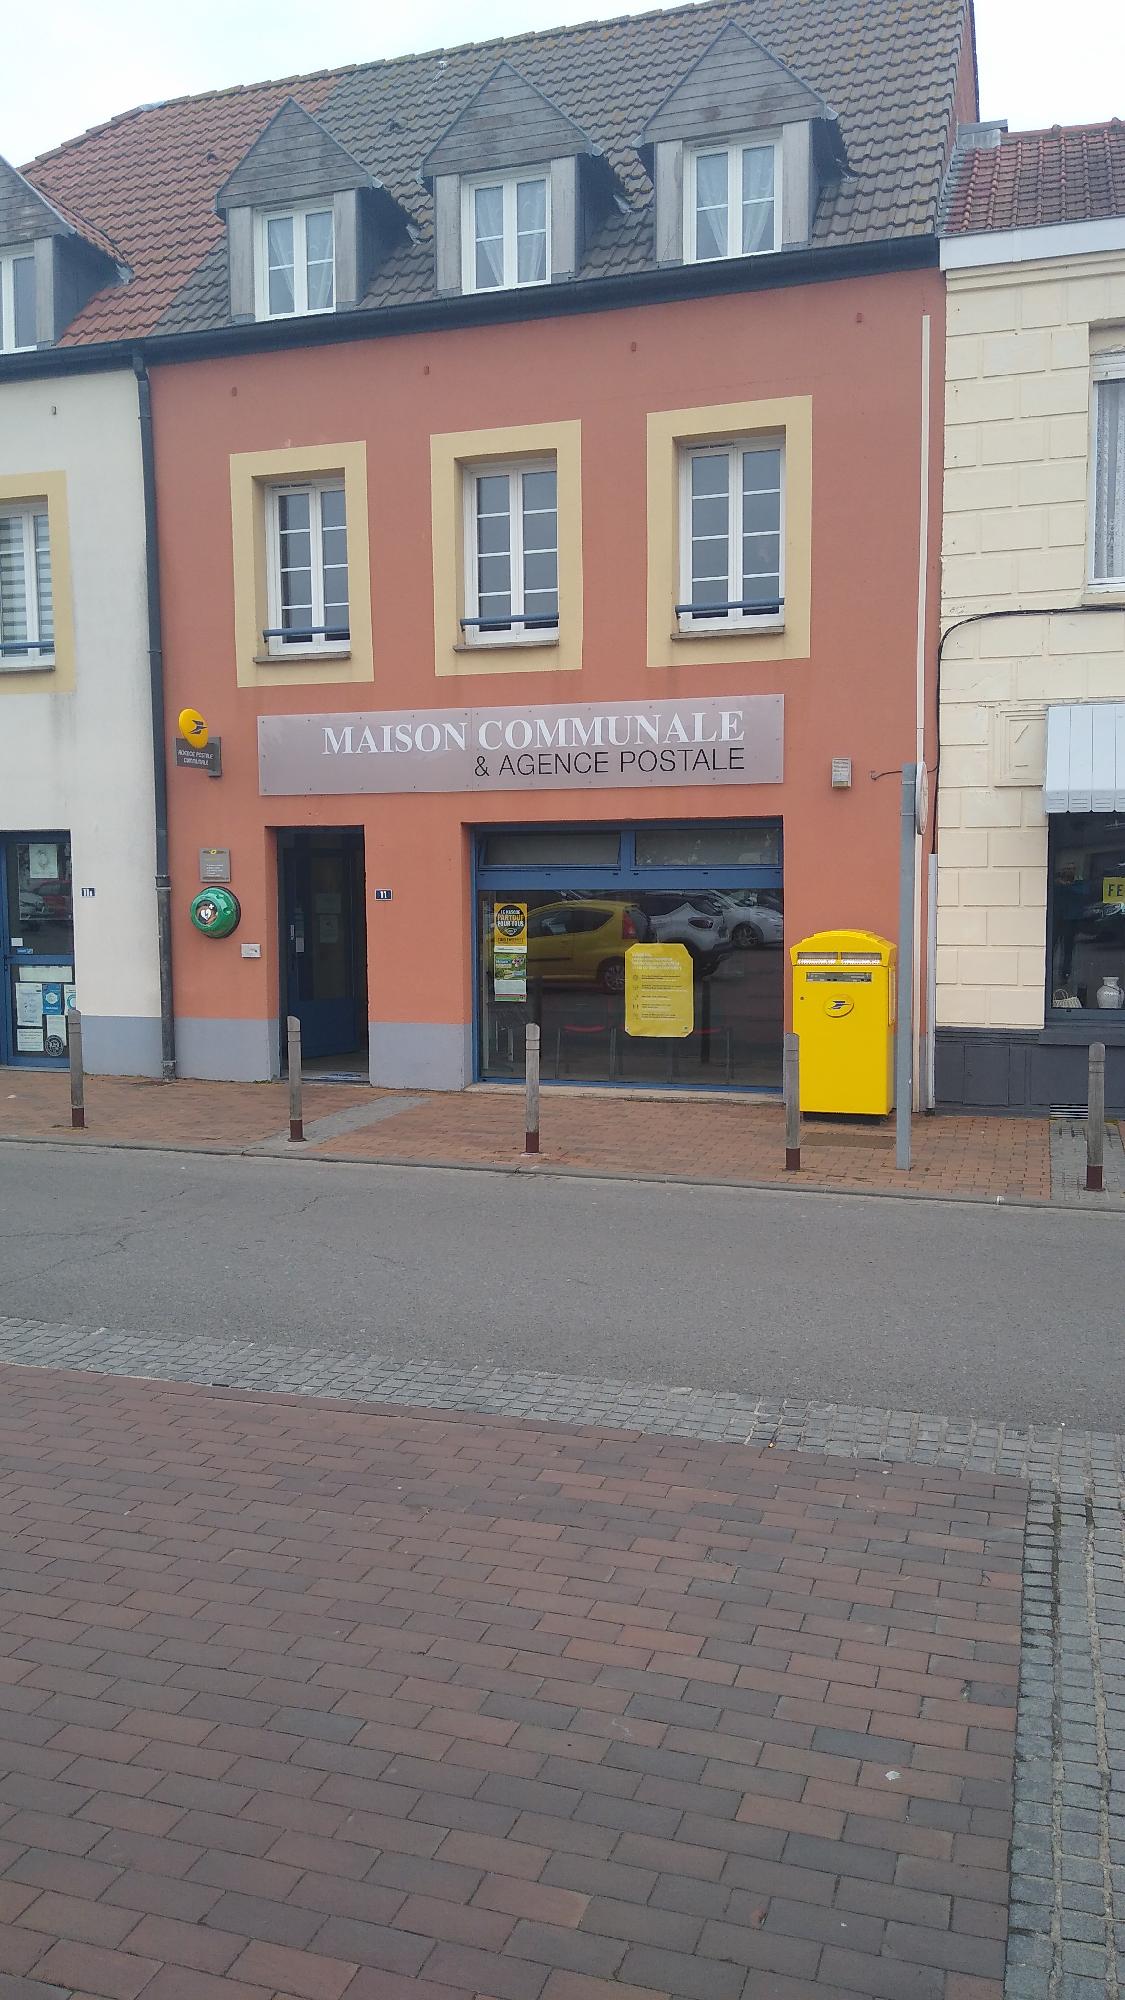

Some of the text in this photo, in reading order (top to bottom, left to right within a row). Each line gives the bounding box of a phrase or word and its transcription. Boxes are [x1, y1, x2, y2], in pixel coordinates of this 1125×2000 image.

[321, 710, 745, 755] MAISON COMMUNALE
[474, 747, 745, 777] & AGENCE POSTALE
[380, 890, 387, 898] 11
